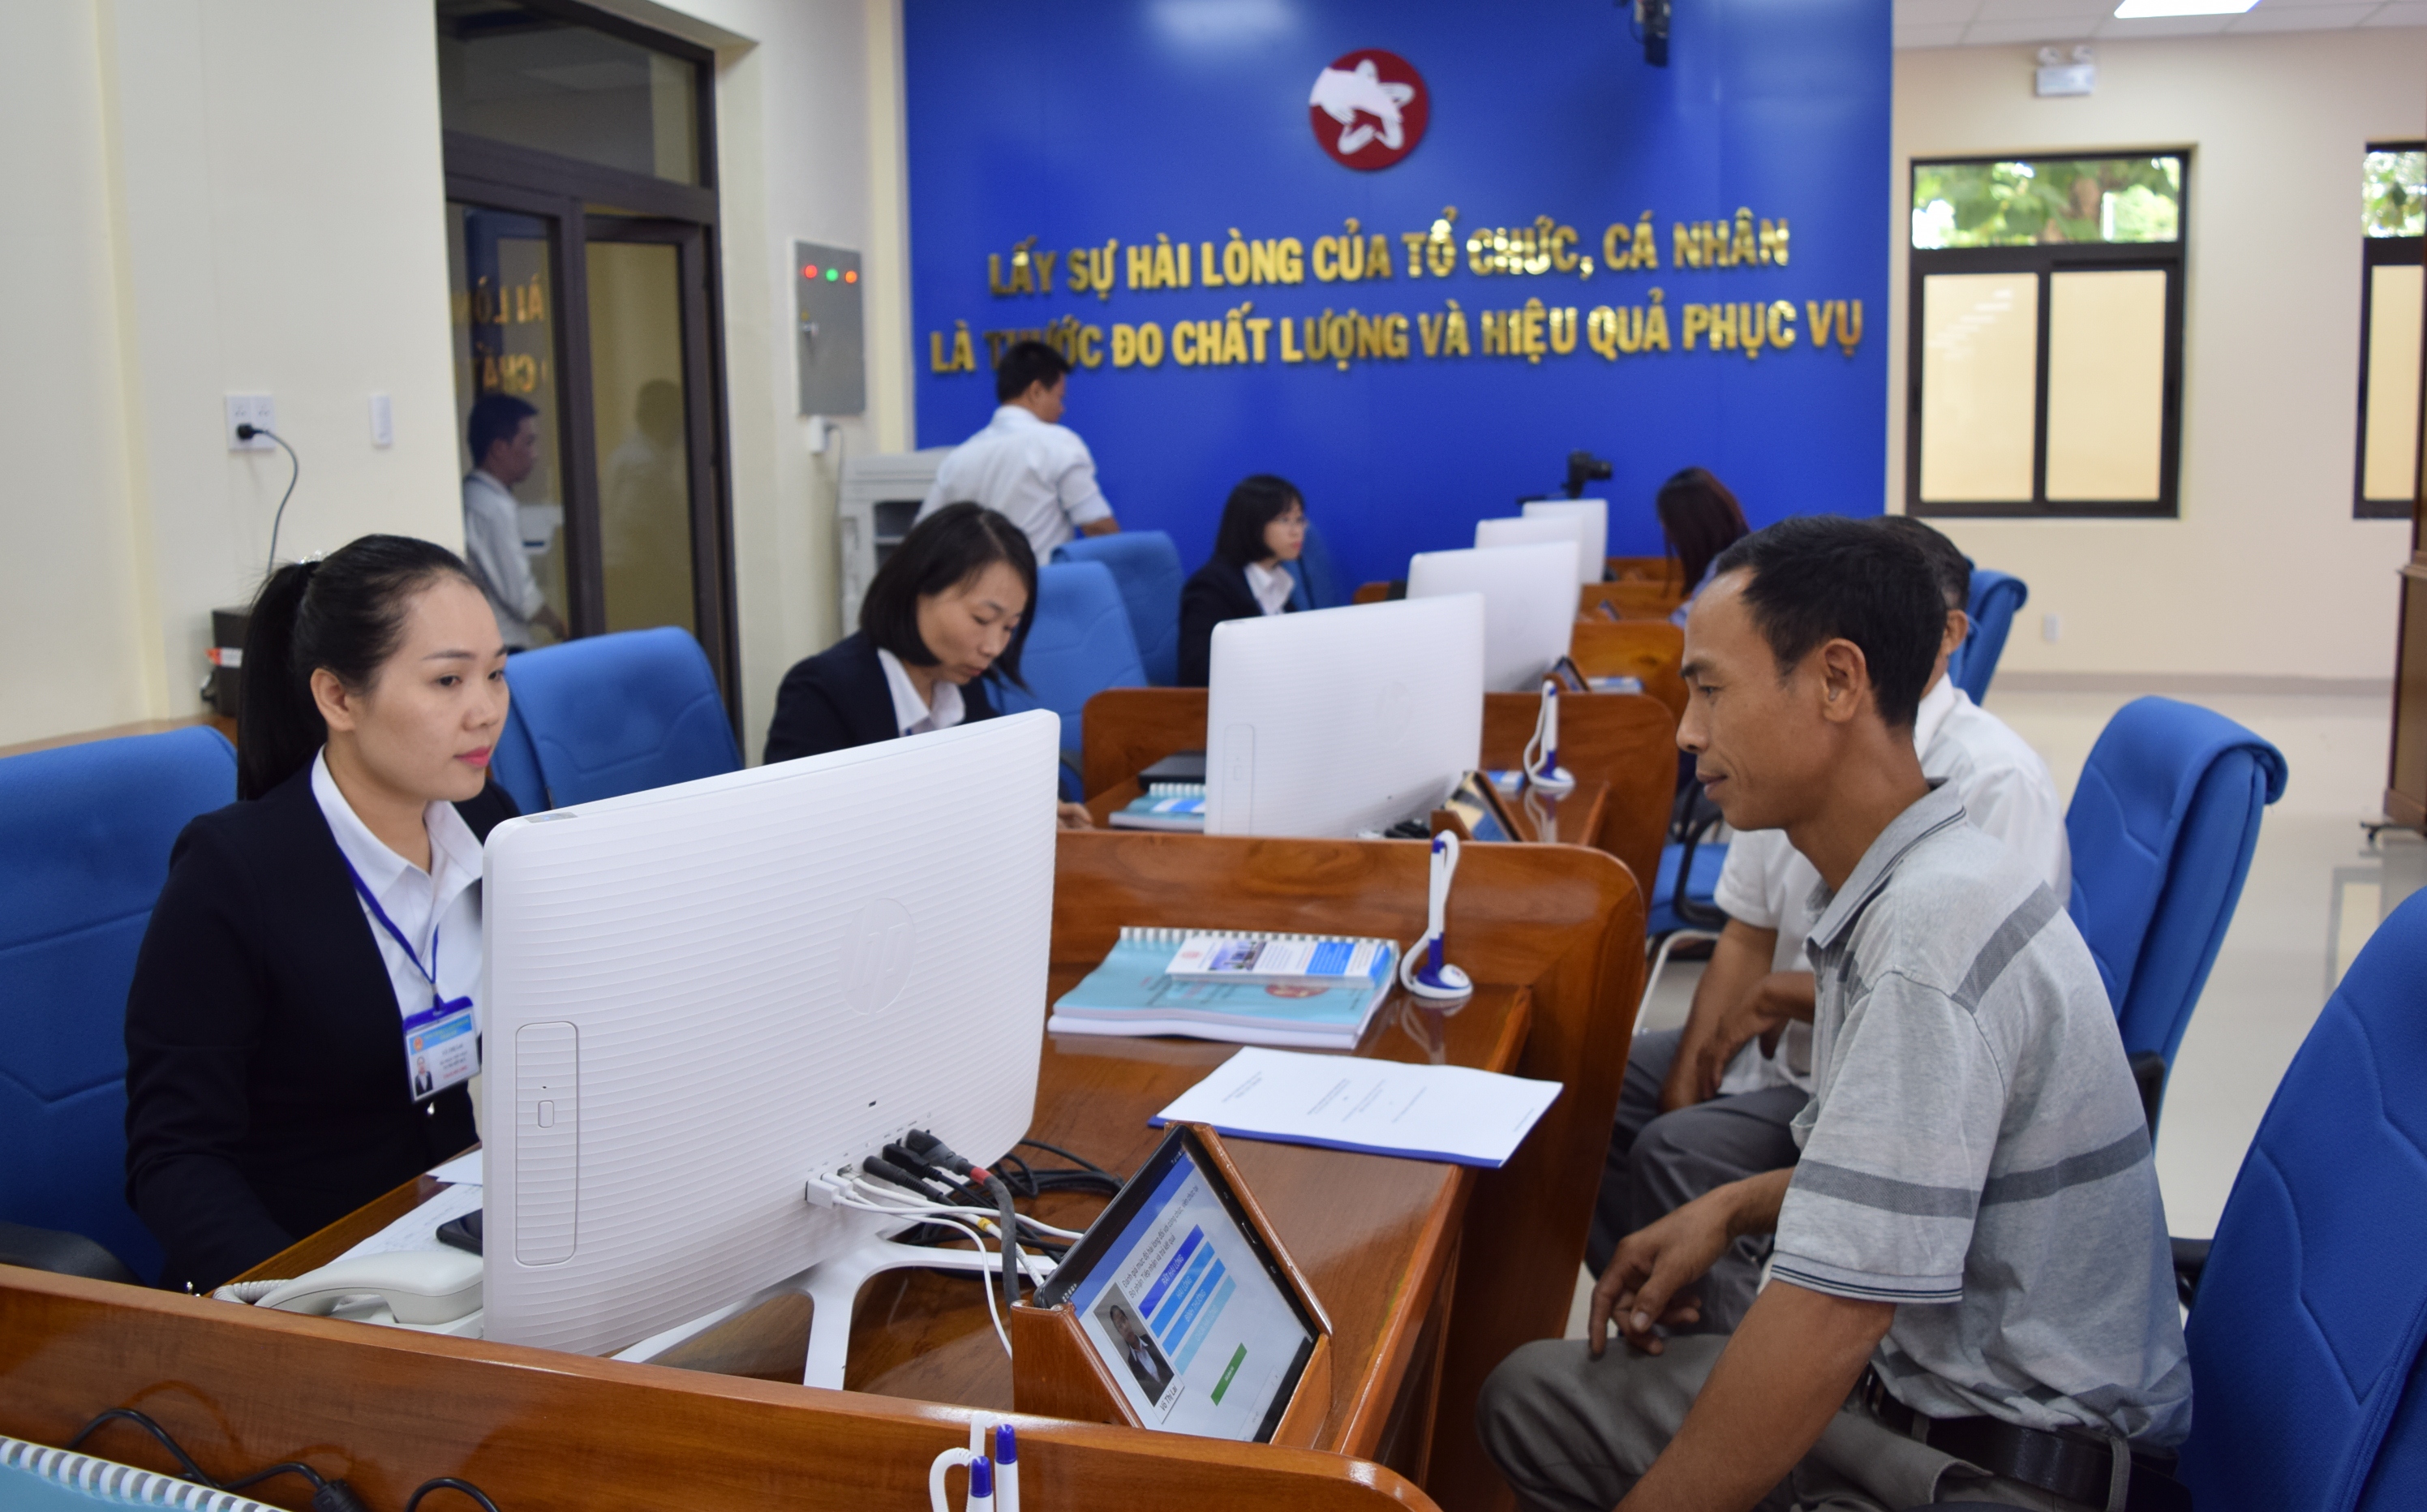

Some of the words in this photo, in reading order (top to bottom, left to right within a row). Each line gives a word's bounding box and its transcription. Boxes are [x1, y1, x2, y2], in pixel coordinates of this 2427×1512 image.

[988, 236, 1055, 294] LẤY
[1067, 238, 1119, 300] SỰ
[1128, 234, 1190, 289] HÀI
[1201, 227, 1304, 286] LÒNG
[1312, 217, 1392, 281] CỦA
[1402, 205, 1457, 277] TỔ
[1466, 215, 1594, 280] CHỨC,
[1603, 209, 1658, 271] CÁ
[1673, 207, 1789, 268] NHÂN
[930, 320, 975, 372] LÀ
[1111, 323, 1164, 367] ĐO
[1172, 302, 1271, 365] CHẤT
[1281, 307, 1409, 370] LƯỢNG
[1418, 299, 1470, 357] VÀ
[1481, 297, 1578, 363] HIỆU
[1587, 286, 1670, 361] QUẢ
[1682, 300, 1796, 359] PHỤC
[1806, 299, 1862, 357] VỤ
[1122, 1271, 1133, 1288] Đánh
[1160, 1270, 1170, 1286] RẤT
[1166, 1262, 1176, 1278] HÀI
[1171, 1251, 1183, 1269] LÒNG
[1159, 1398, 1167, 1412] Võ
[1163, 1390, 1174, 1407] Thị
[1169, 1382, 1178, 1396] Lai
